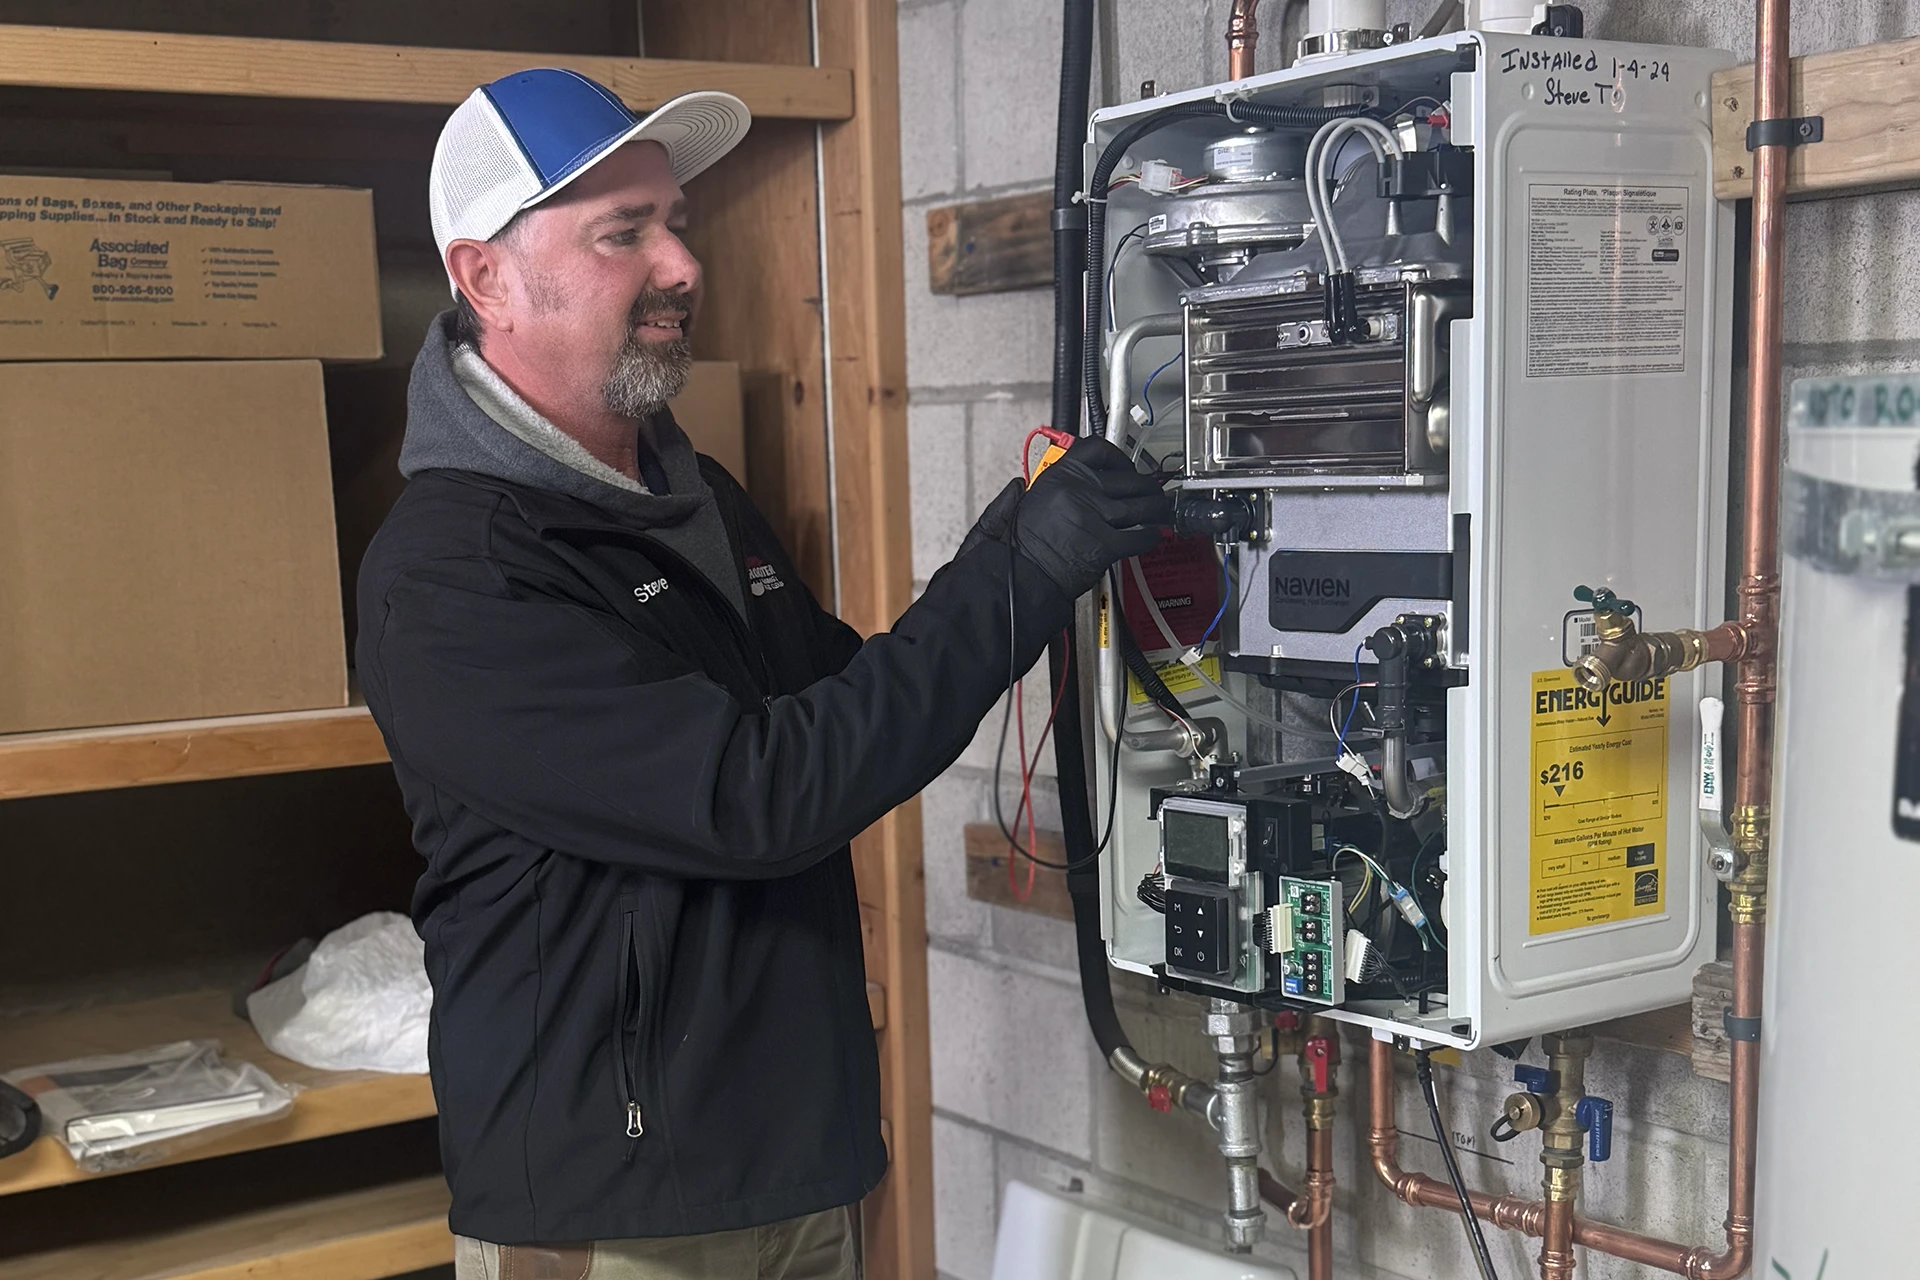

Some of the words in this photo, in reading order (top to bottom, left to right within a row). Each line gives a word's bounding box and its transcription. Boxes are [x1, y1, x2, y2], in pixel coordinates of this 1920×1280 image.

[1544, 78, 1590, 105] Steve
[1563, 188, 1582, 197] Rating
[25, 196, 38, 206] of
[42, 197, 78, 209] Bags,
[82, 198, 125, 211] Boxes,
[129, 201, 152, 211] and
[156, 201, 190, 212] Other
[193, 202, 256, 216] Packaging
[259, 205, 282, 216] and
[124, 212, 160, 224] Stock
[164, 214, 187, 225] and
[190, 215, 228, 228] Ready
[231, 217, 244, 227] to
[246, 217, 277, 229] Ship!
[89, 238, 169, 254] Associated
[97, 254, 127, 270] Bag
[130, 257, 168, 268] Company
[92, 284, 174, 296] 800-926-6100
[633, 577, 669, 603] Steve
[1158, 597, 1192, 609] WARNING
[1569, 744, 1591, 753] Estimated
[1592, 743, 1605, 751] Yearly
[1606, 741, 1621, 749] Energy
[1540, 761, 1584, 786] $216
[1554, 836, 1576, 845] Maximum
[1576, 833, 1593, 842] Gallons
[1602, 830, 1617, 838] Minute
[1174, 903, 1181, 912] M
[1174, 946, 1183, 957] OK
